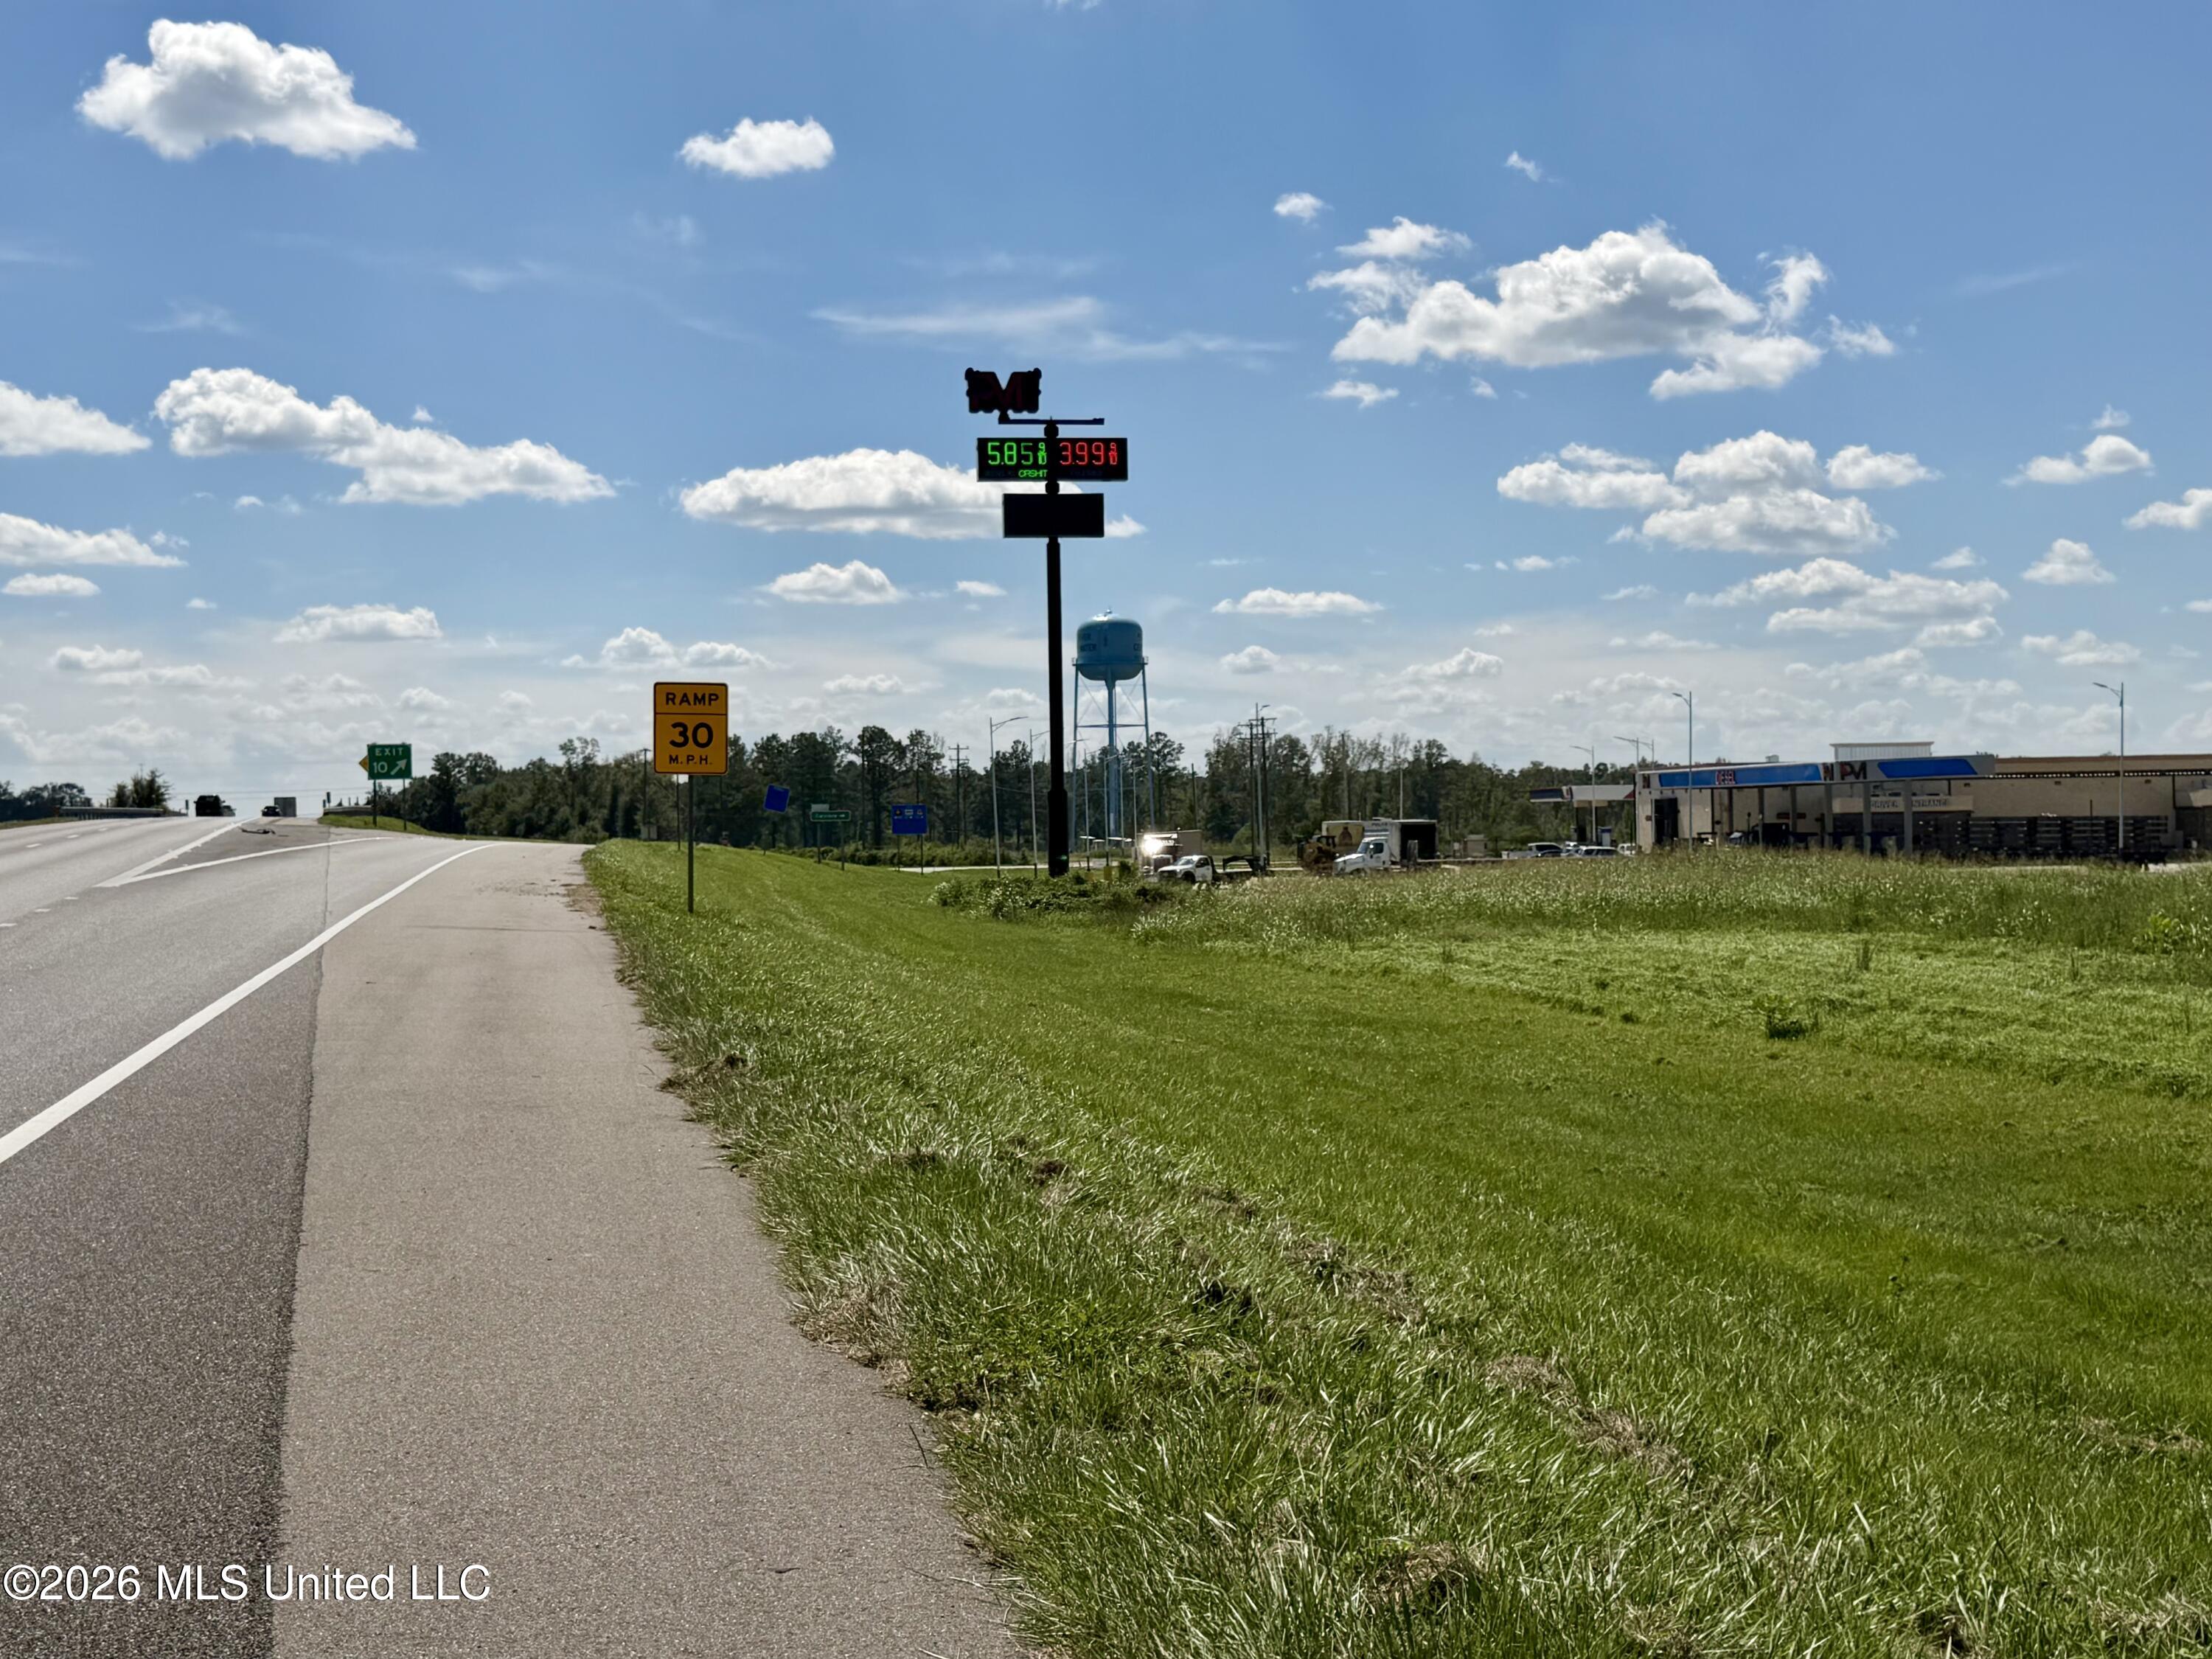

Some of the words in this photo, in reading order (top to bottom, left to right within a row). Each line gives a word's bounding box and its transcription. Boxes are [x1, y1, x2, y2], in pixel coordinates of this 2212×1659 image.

[665, 692, 720, 706] RAMP
[669, 722, 714, 748] 30
[375, 748, 403, 757] EXIT
[669, 754, 714, 765] M.P.H.
[372, 761, 389, 774] 10
